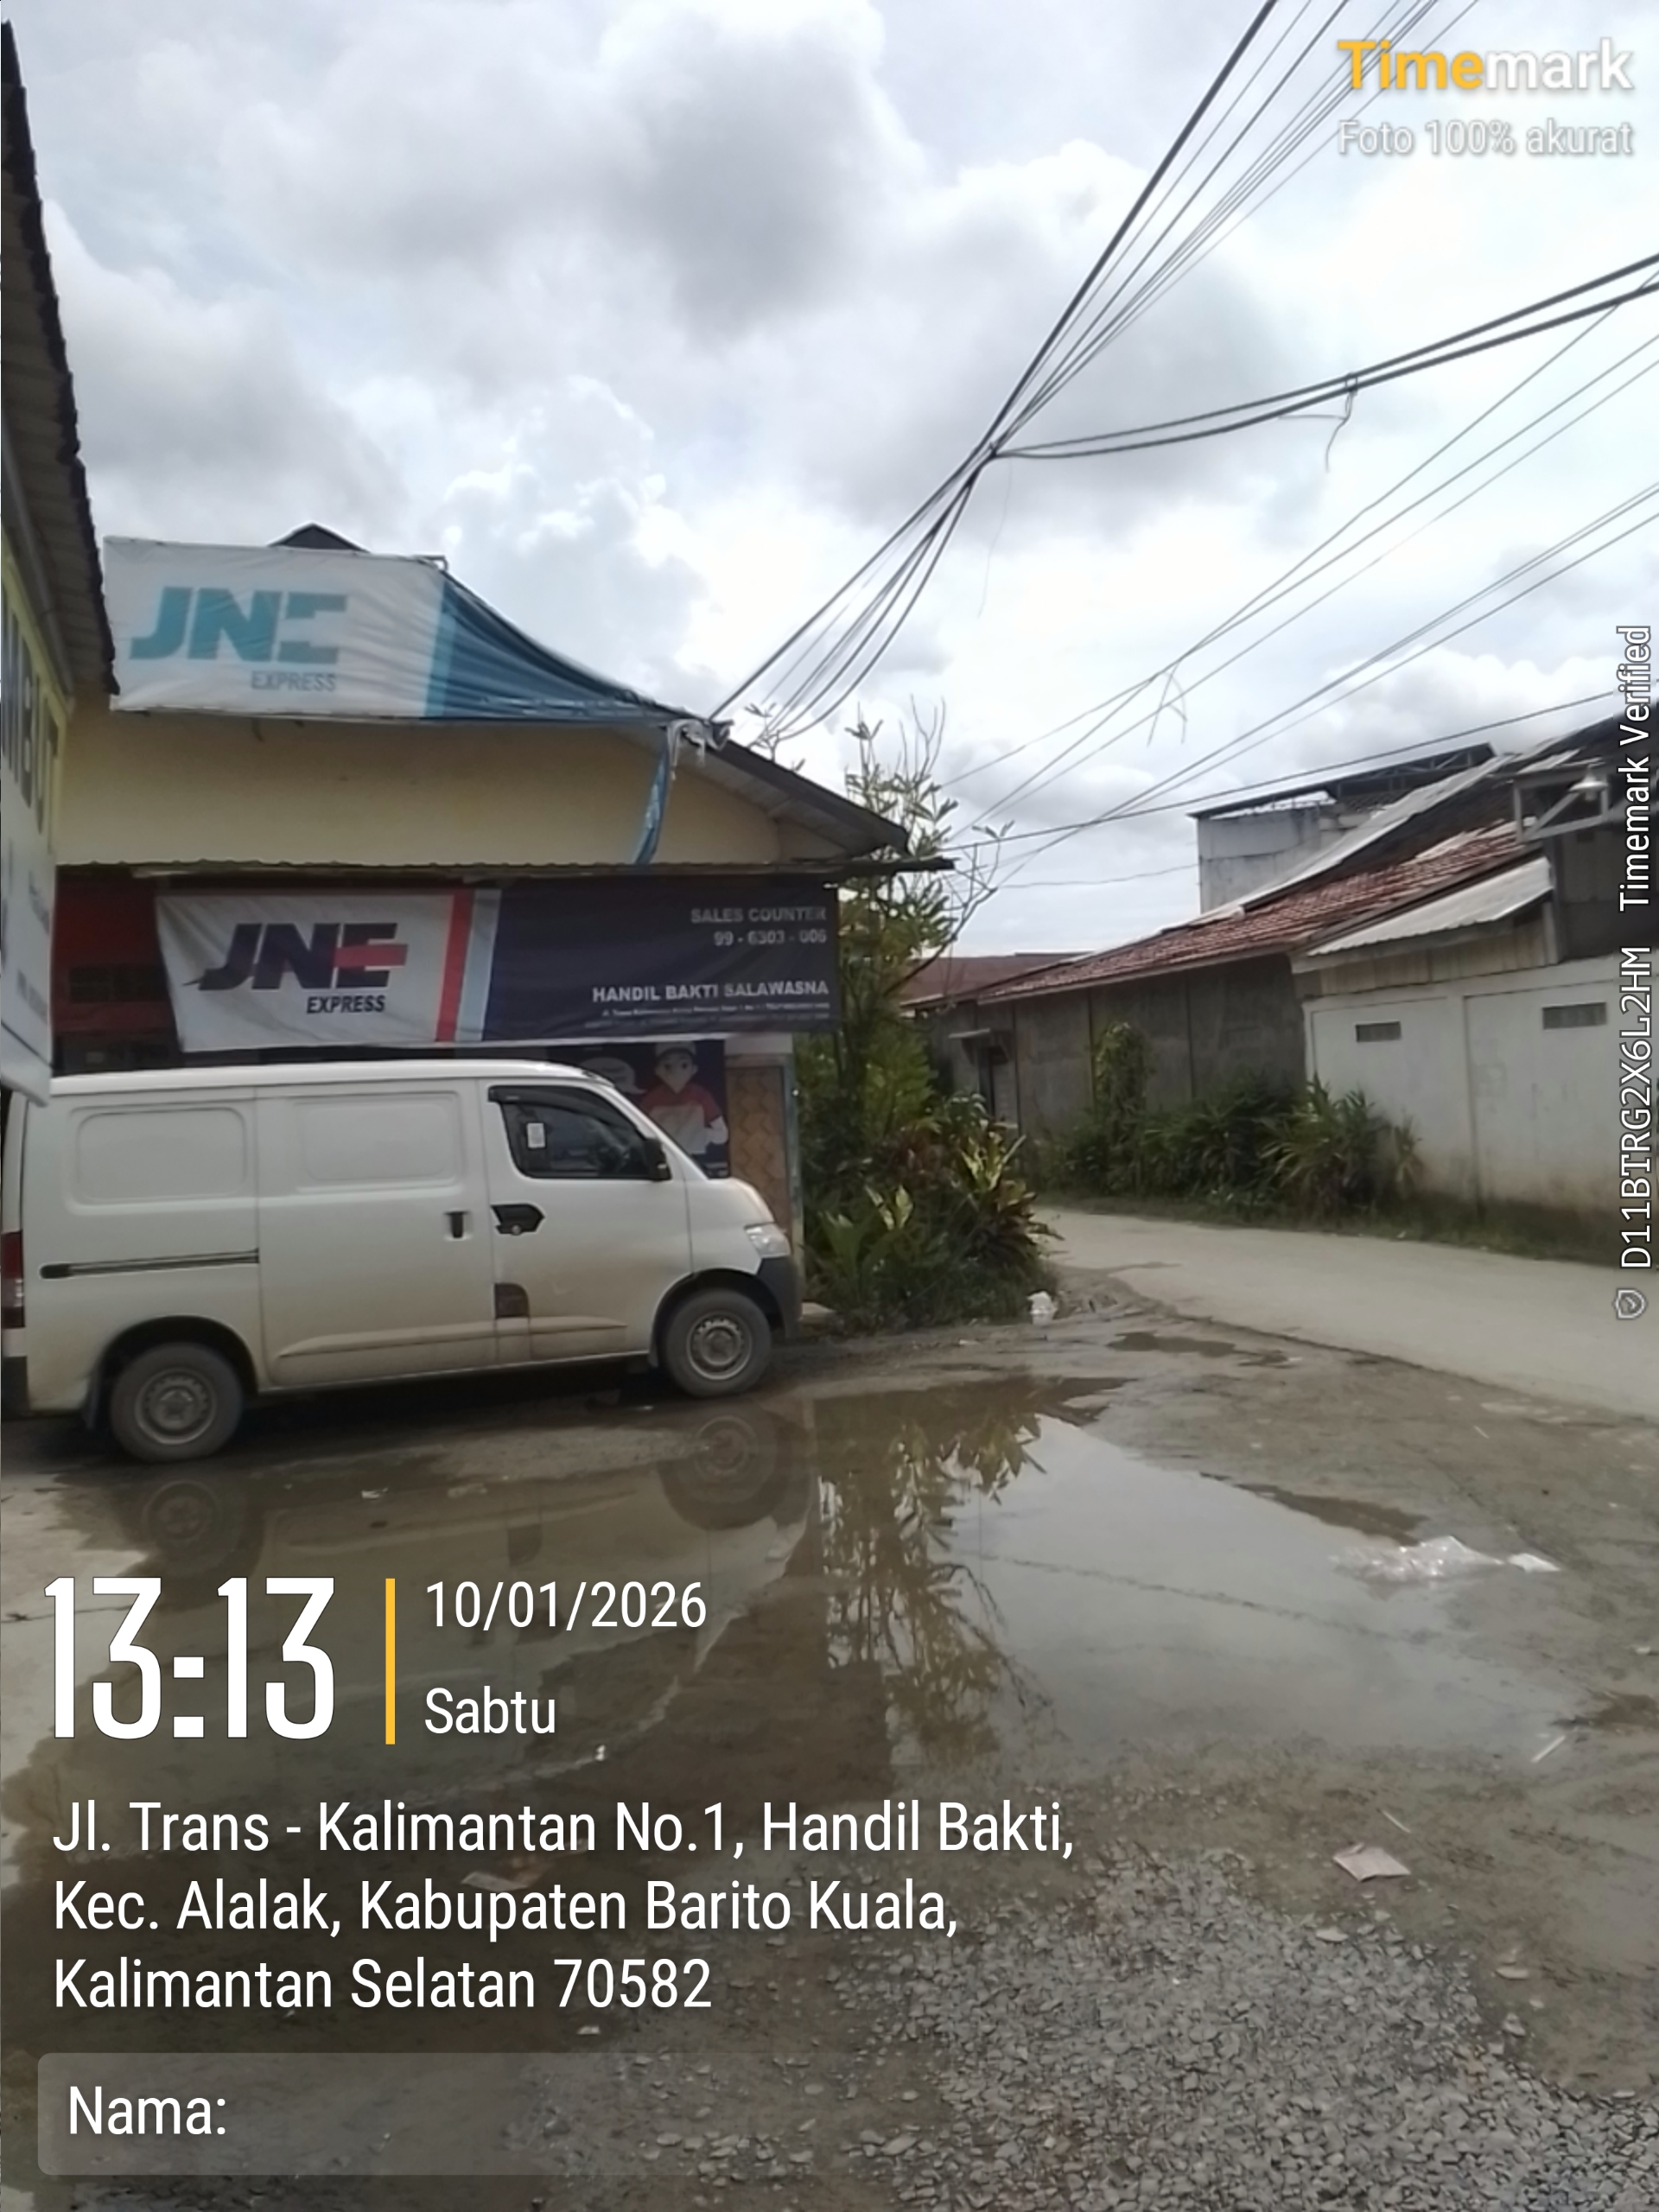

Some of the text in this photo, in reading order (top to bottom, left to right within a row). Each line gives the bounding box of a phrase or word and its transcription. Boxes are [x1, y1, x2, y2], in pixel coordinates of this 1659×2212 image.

[129, 585, 348, 664] JNE
[250, 671, 337, 693] EXPRESS
[690, 906, 827, 924] SALES COUNTER
[714, 931, 734, 946] 99
[184, 922, 408, 992] JNE
[593, 980, 830, 1003] HANDIL BAKTI SALAWASNA
[306, 994, 386, 1014] EXPRESS
